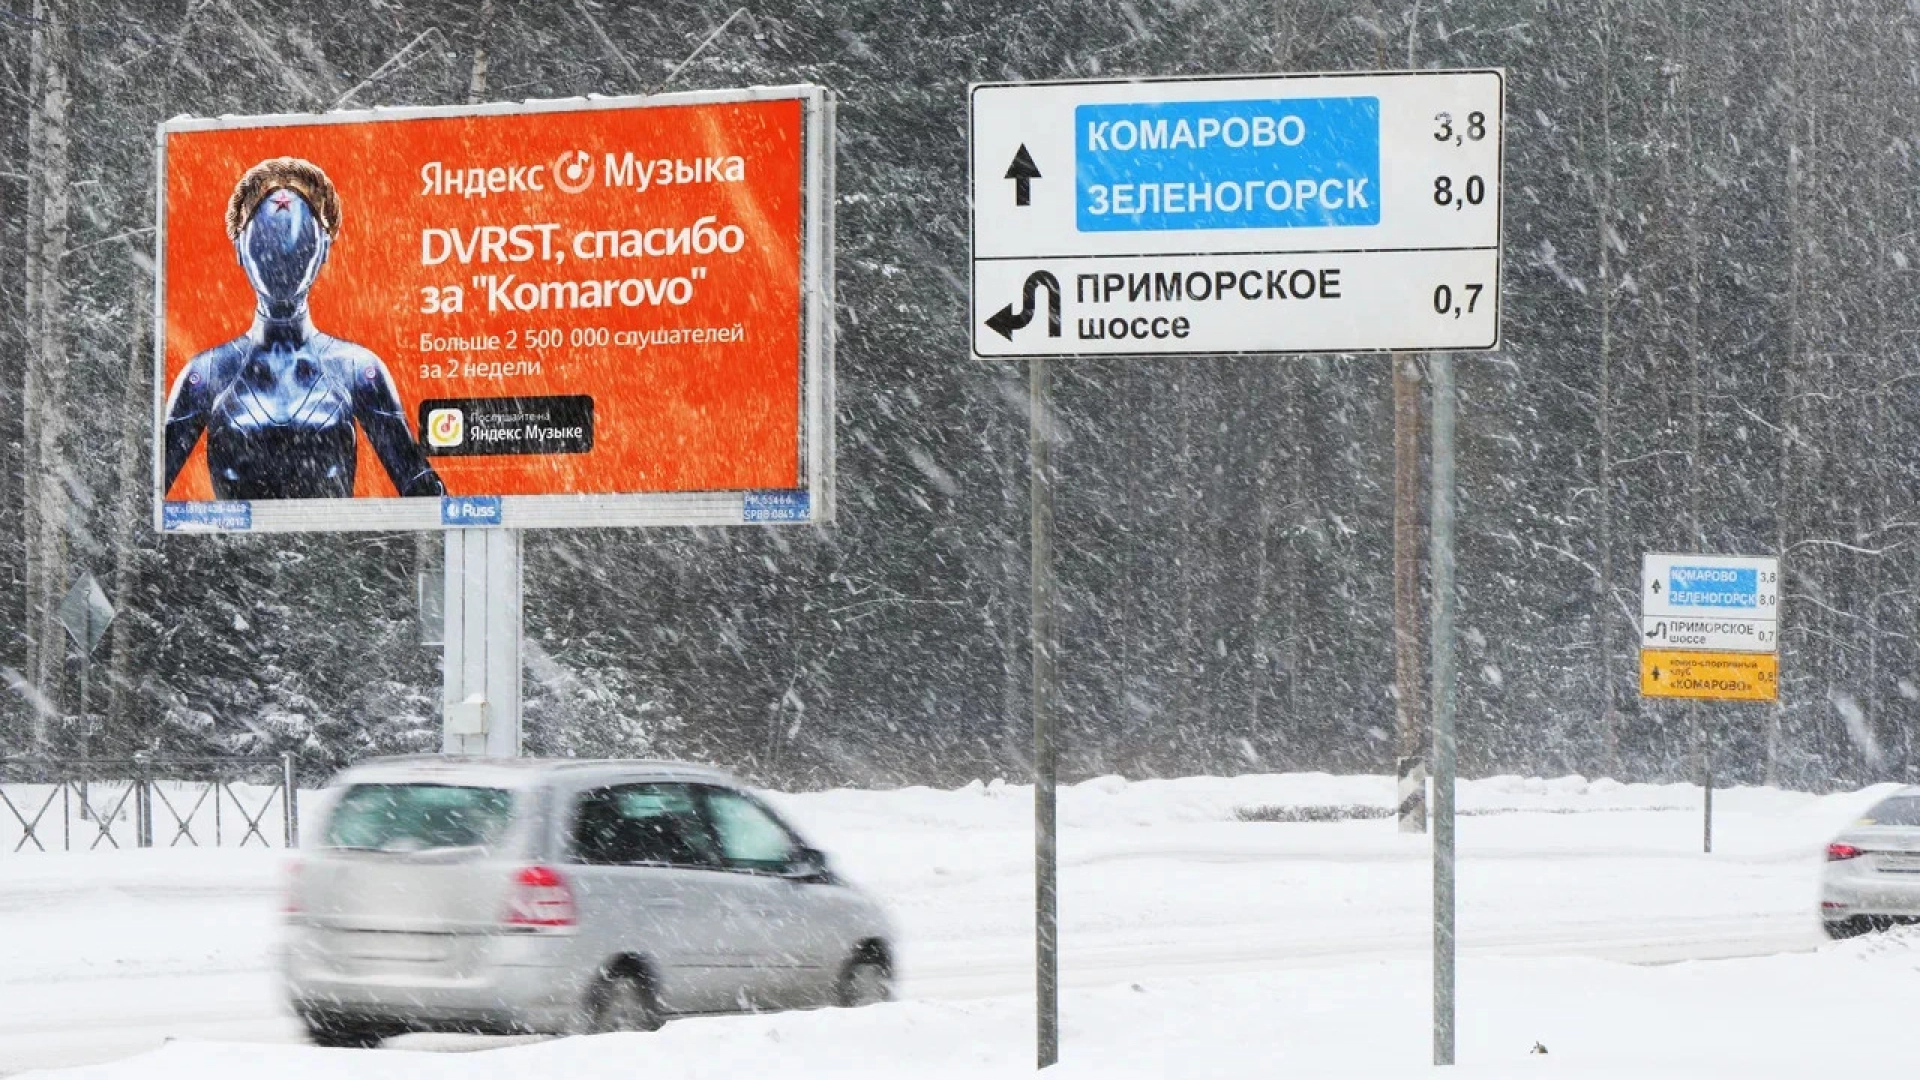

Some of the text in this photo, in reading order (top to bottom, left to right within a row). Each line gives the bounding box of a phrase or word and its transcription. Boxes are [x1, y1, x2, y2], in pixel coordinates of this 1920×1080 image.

[1088, 111, 1486, 151] КОМАРОВО 3,8
[421, 152, 745, 198] Яндекс Музыка
[1088, 175, 1485, 216] ЗЕЛЕНОГОРСК 8,0
[422, 216, 745, 265] DVRST, спасибо
[420, 267, 706, 314] за "Komarovo"
[1077, 268, 1484, 319] ПРИМОРСКОЕ 0,7
[419, 324, 745, 351] Больше 2 500 000 слушателей
[1078, 315, 1191, 340] шоссе
[419, 360, 541, 380] за 2 недели
[470, 424, 583, 441] Яндекс Музыке
[462, 503, 496, 516] Russ
[1670, 569, 1776, 583] КОМАРОВО 3,8
[1670, 591, 1775, 606] ЗЕЛЕНОГОРСК 8,0
[1669, 635, 1706, 644] шоссе
[1670, 621, 1775, 642] ПРИМОРСКОЕ 0,7
